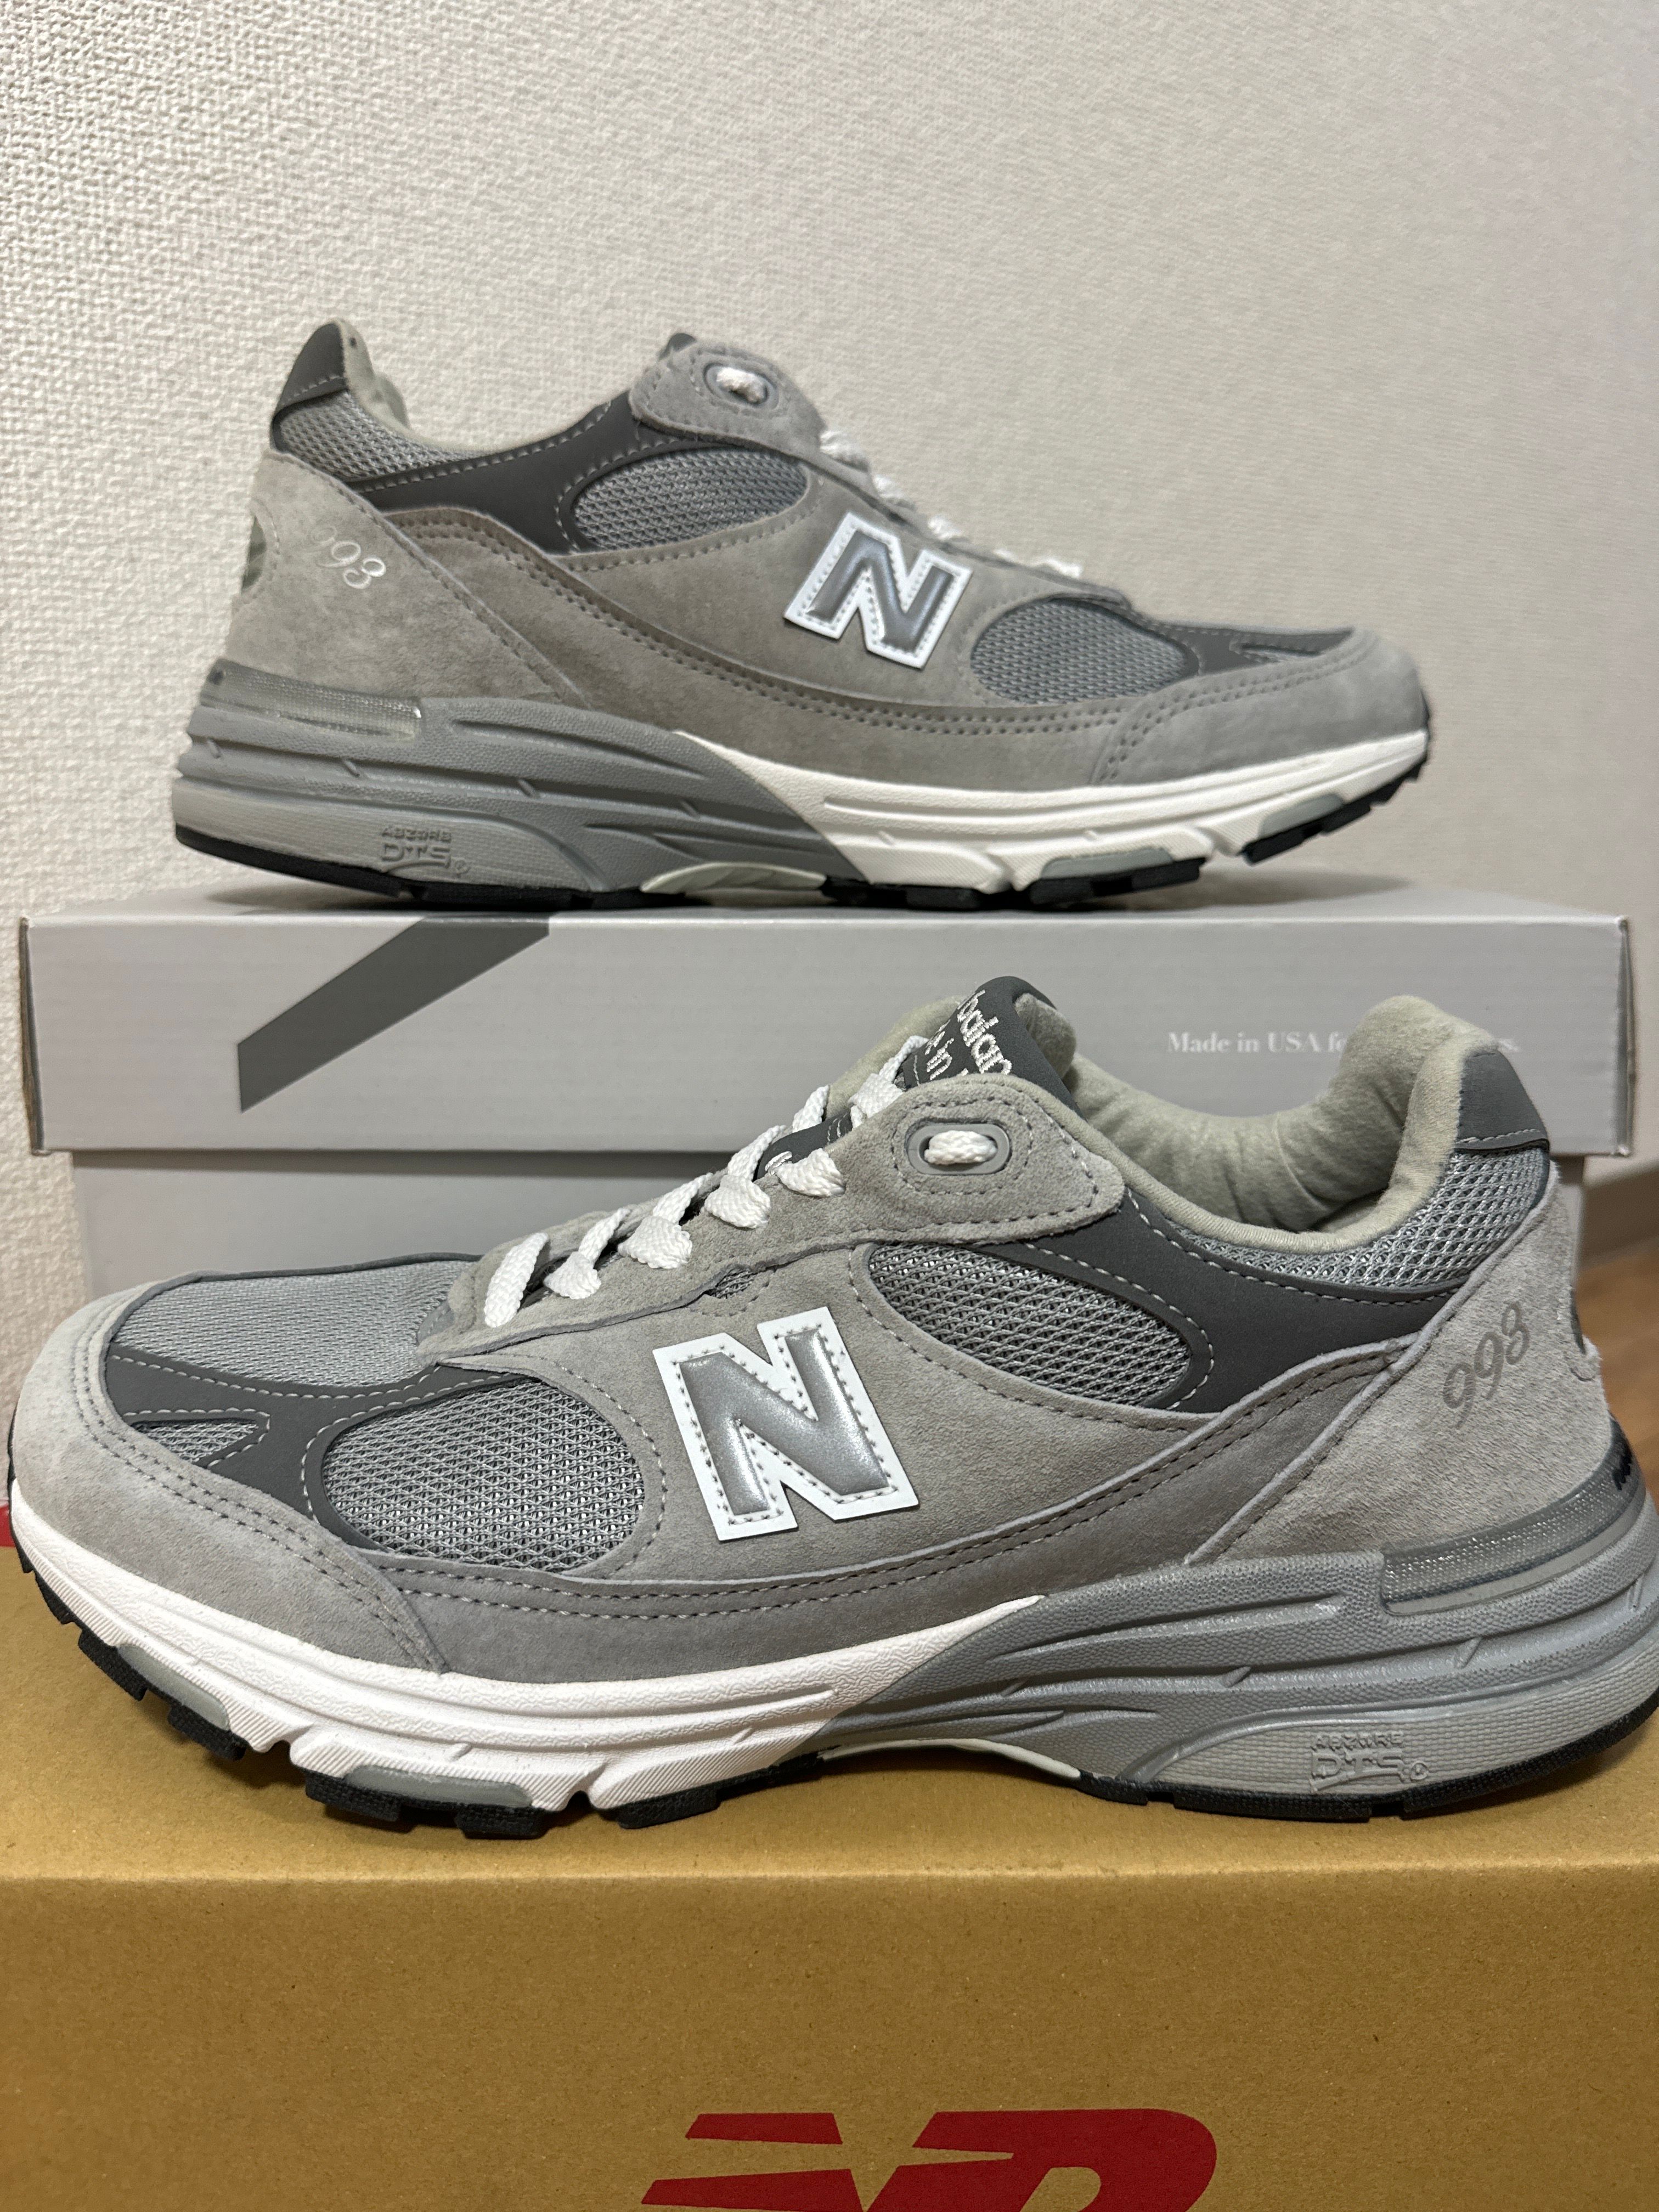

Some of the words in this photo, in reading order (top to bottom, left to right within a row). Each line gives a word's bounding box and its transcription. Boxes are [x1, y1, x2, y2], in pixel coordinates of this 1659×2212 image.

[784, 512, 974, 670] N
[956, 989, 1012, 1075] balan
[1167, 1031, 1229, 1053] Made
[1237, 1031, 1260, 1053] in
[1267, 1031, 1321, 1053] USA
[1328, 1031, 1349, 1053] fo
[652, 1306, 919, 1541] N
